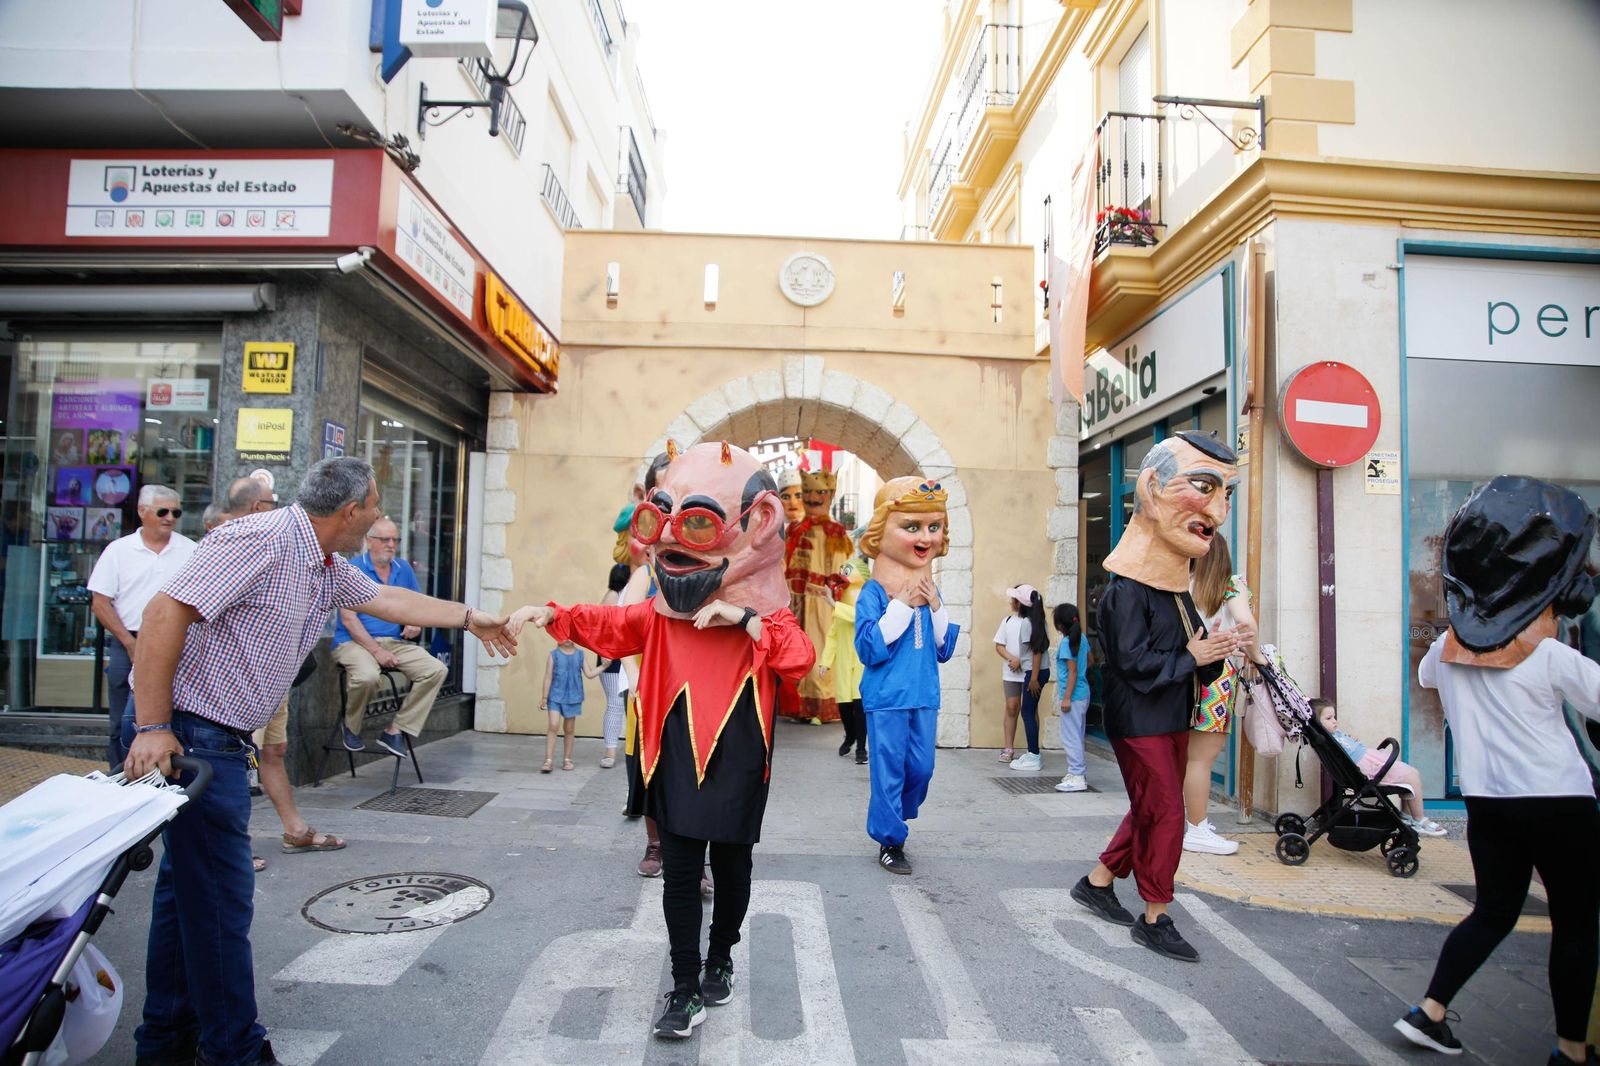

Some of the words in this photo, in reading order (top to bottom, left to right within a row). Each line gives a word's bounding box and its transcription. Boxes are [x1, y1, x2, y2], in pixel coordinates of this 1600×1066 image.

[142, 164, 204, 177] Loterías
[208, 167, 217, 179] y
[141, 181, 211, 196] Apuestas
[217, 181, 239, 193] del
[244, 181, 297, 193] Estado
[1078, 344, 1156, 432] aBelia
[240, 452, 263, 461] Punto
[265, 453, 286, 461] Pack
